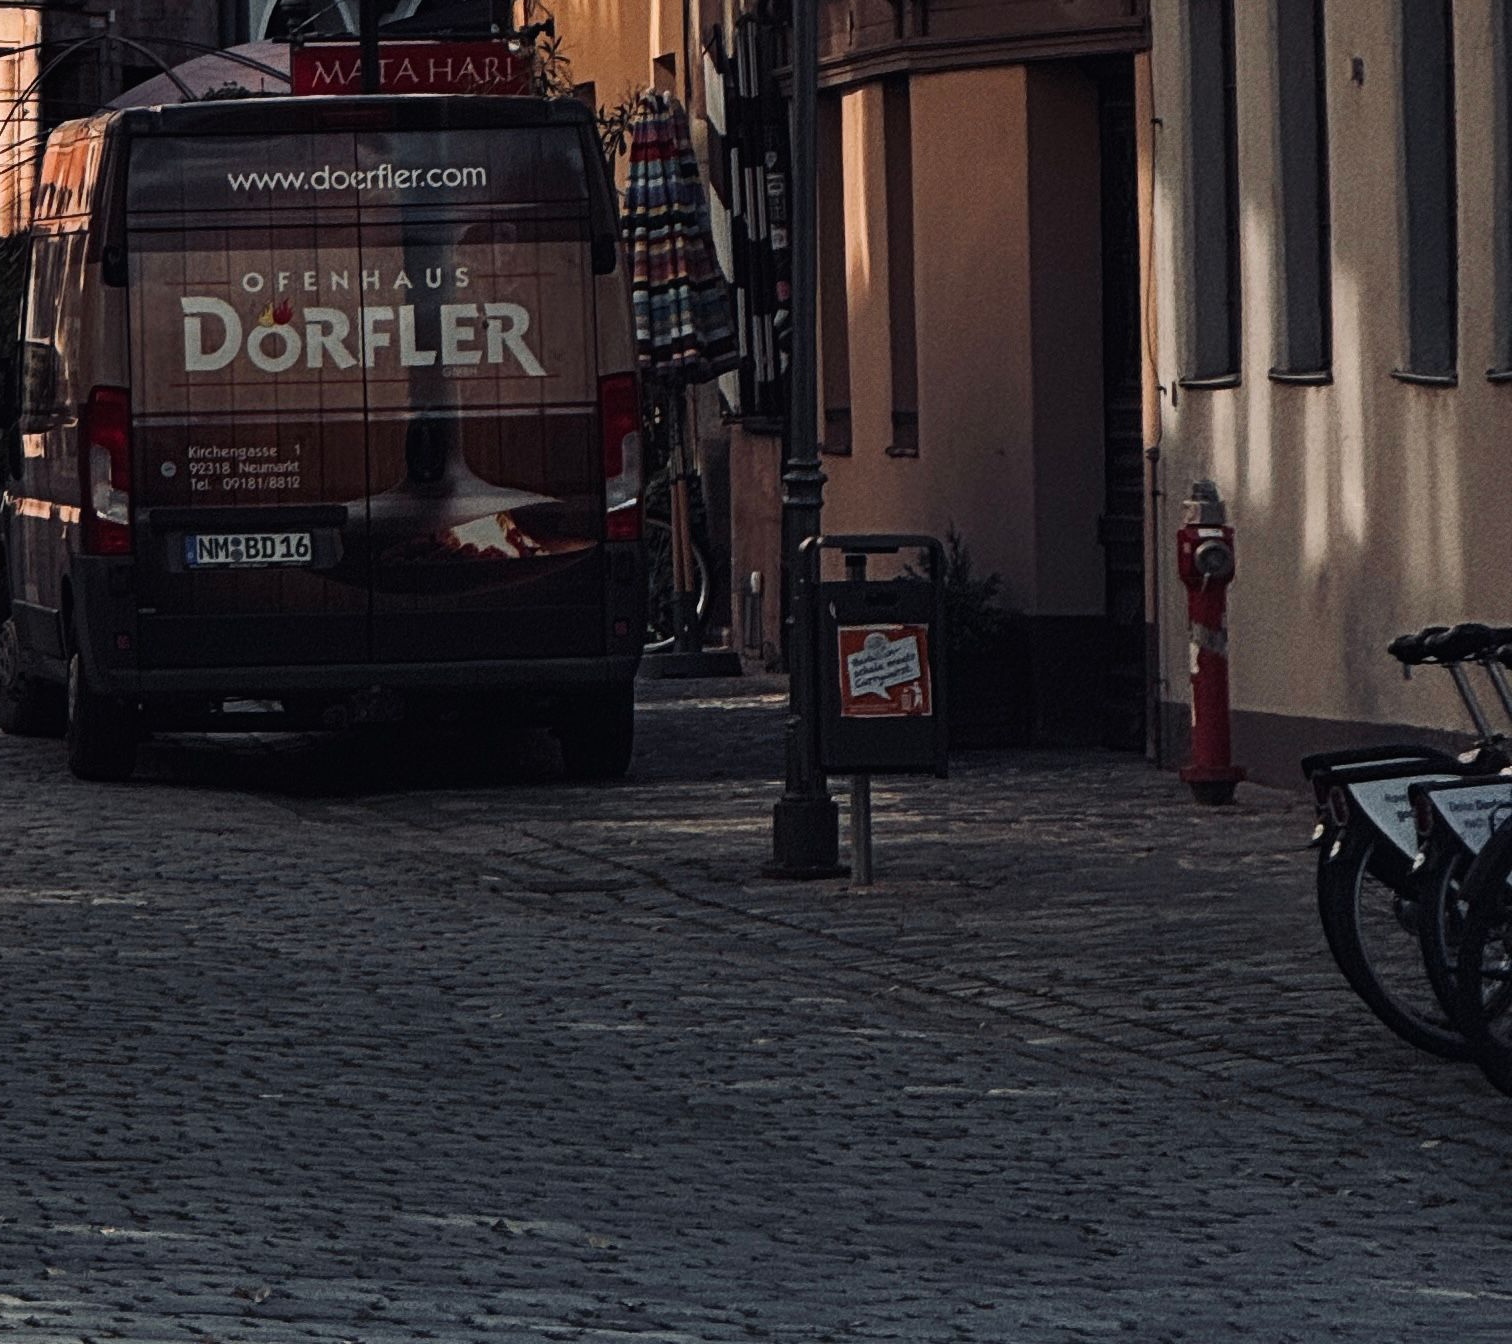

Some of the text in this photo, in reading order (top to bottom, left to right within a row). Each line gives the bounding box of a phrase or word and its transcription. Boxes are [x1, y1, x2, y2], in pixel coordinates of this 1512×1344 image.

[428, 56, 513, 86] HARI
[227, 164, 487, 191] www.doerfler.com
[241, 267, 470, 294] OFENHAUS
[188, 444, 301, 461] Kirchengasse 1
[189, 461, 300, 475] 92318 Neumarkt
[223, 476, 301, 490] 09181/8812
[199, 535, 309, 560] NM BD 16
